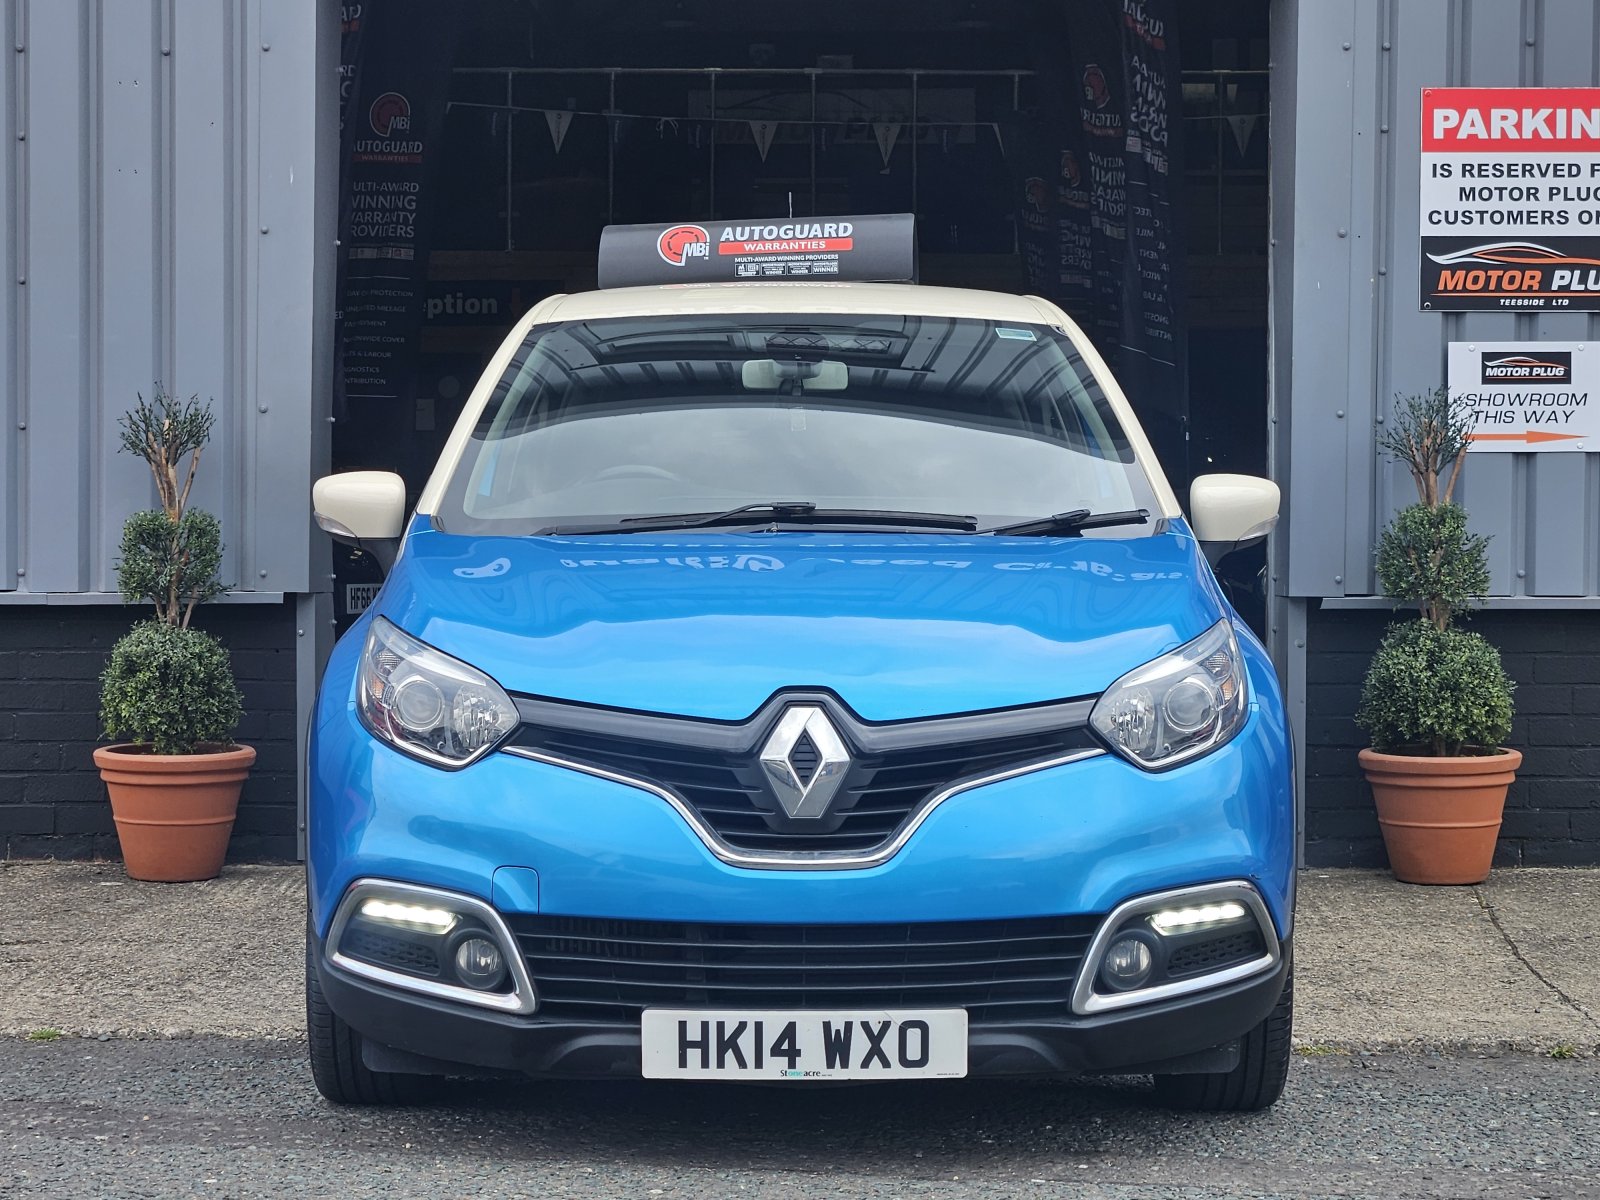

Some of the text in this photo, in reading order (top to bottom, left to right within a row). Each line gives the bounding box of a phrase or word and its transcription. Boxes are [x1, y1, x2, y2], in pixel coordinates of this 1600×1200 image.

[1432, 108, 1600, 140] PARKIN
[1431, 163, 1600, 178] IS RESERVED F
[353, 181, 420, 193] ULTI-AWRD
[1458, 186, 1541, 202] MOTOR
[351, 211, 416, 224] ARRANTY
[1427, 210, 1570, 226] CUSTOMERS
[351, 224, 415, 238] ROVIDERS
[719, 222, 854, 242] AUTOGUARD
[743, 239, 826, 252] WARRANTIES
[1437, 270, 1600, 291] MOTOR PLU
[424, 292, 498, 319] ption
[1499, 298, 1569, 306] TEESSIDE LTD
[1485, 367, 1565, 377] MOTOR PLUG
[1464, 392, 1588, 407] SHOWROOM
[1473, 410, 1576, 424] THIS WAY
[677, 1019, 930, 1070] HK14 WXO
[780, 1069, 821, 1078] Stoneacre
